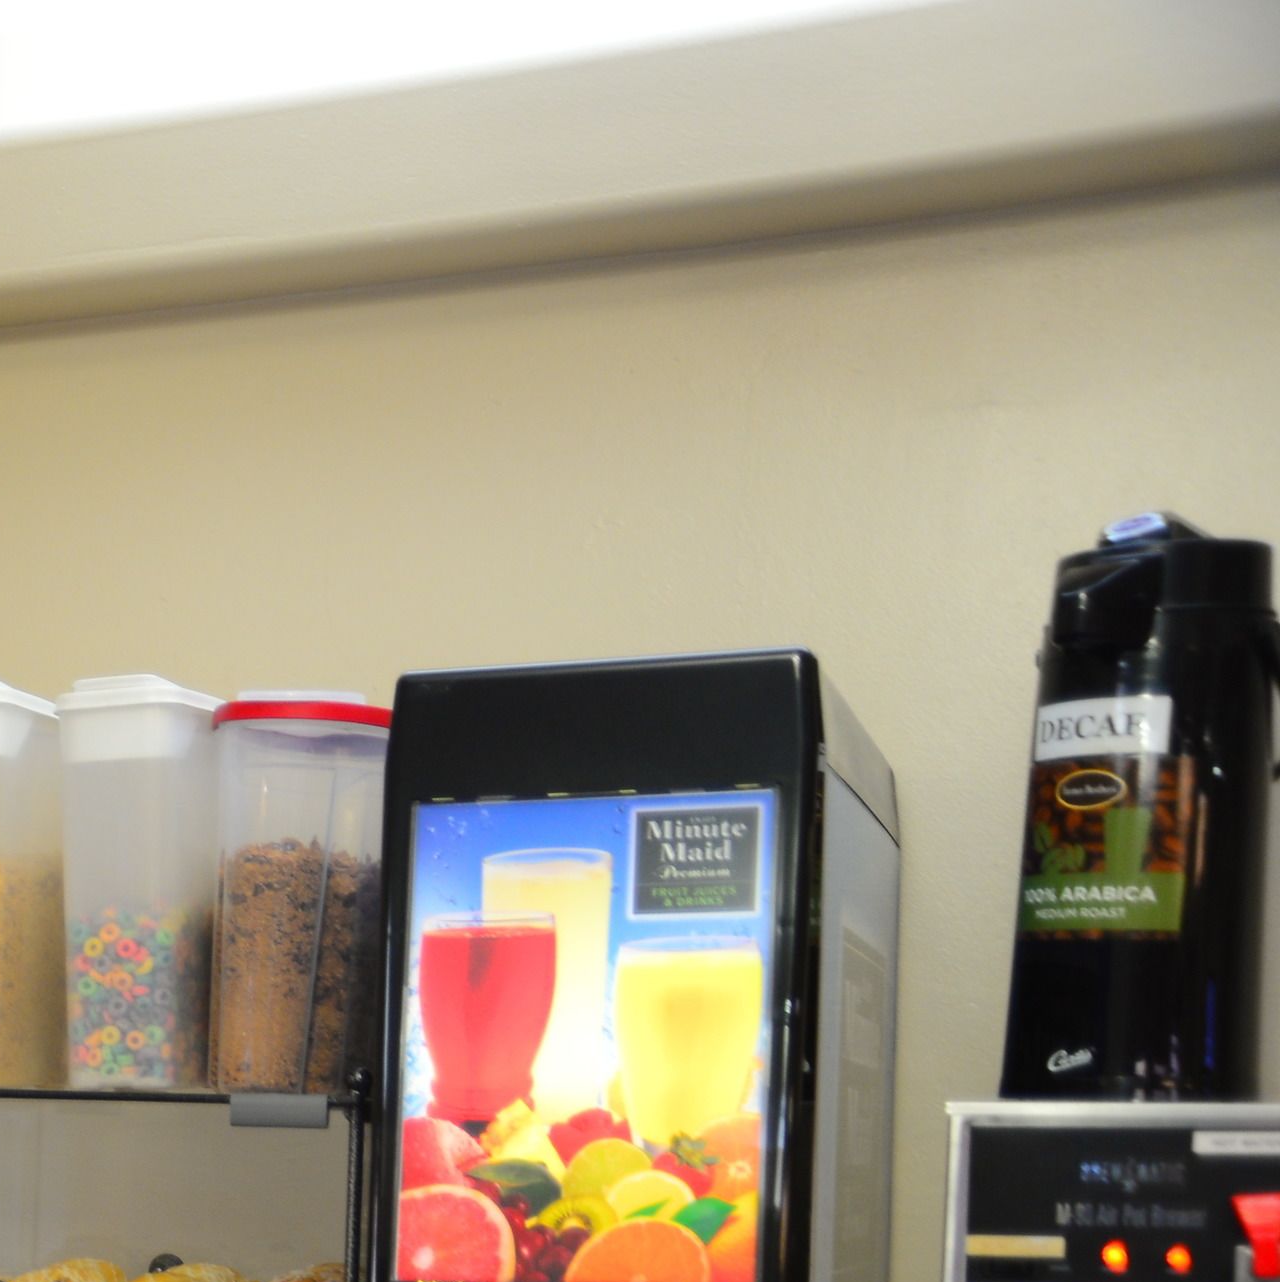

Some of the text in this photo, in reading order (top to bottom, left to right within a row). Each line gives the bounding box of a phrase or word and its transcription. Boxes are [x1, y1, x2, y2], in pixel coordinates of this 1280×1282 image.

[1040, 713, 1146, 744] DECAF
[646, 820, 748, 839] Minute
[660, 840, 732, 861] Maid
[1060, 885, 1157, 904] ARABICA
